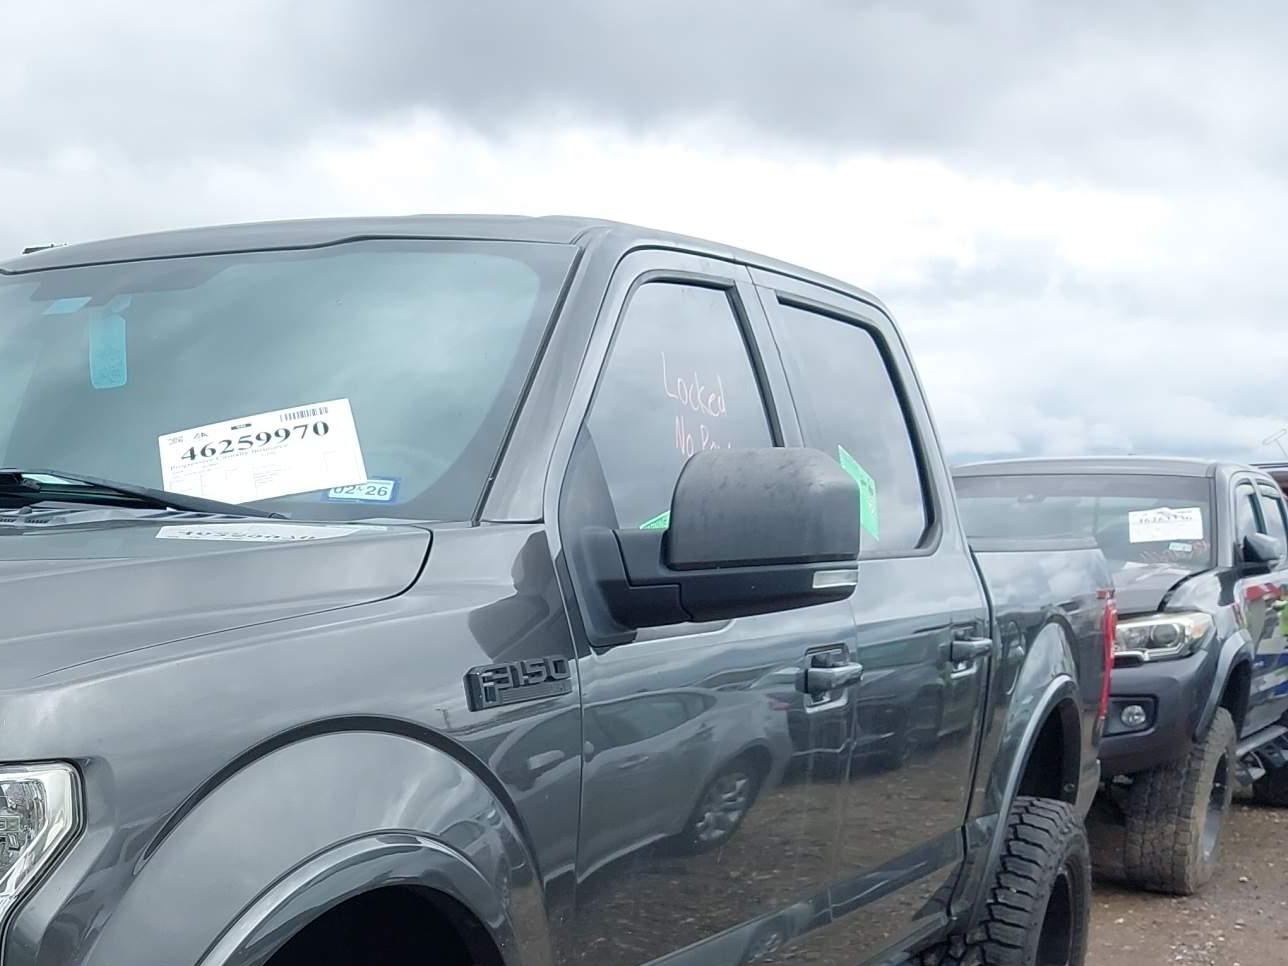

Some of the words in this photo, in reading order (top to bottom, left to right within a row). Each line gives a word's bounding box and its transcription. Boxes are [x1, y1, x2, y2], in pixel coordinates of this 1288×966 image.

[661, 352, 726, 417] Locked
[181, 421, 329, 461] 46259970
[675, 415, 694, 457] No
